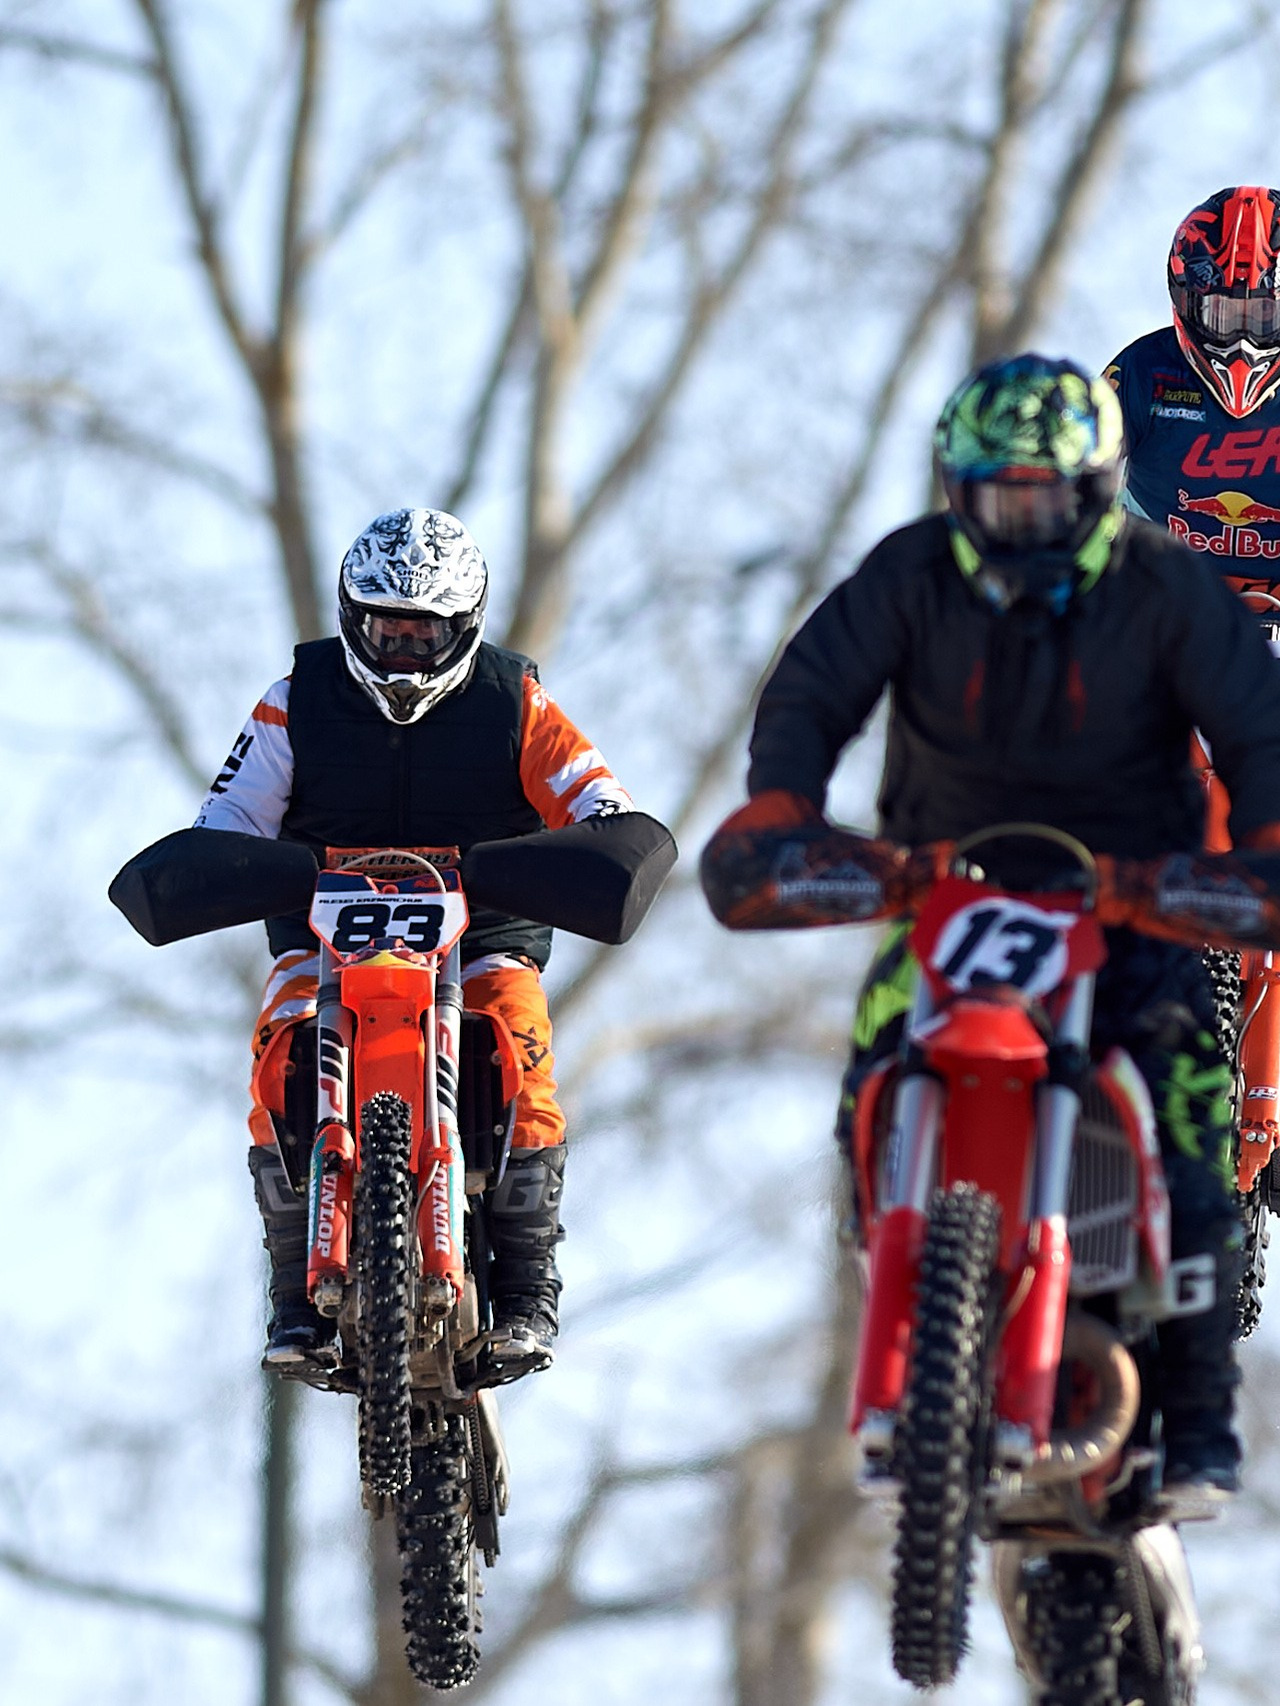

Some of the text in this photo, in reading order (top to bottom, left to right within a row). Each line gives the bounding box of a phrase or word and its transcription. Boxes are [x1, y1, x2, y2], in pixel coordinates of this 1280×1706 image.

[1168, 514, 1233, 556] Red
[331, 904, 445, 952] 83
[944, 909, 1057, 987] 13
[318, 1171, 338, 1258] UNLOP
[432, 1164, 450, 1256] DUNLO
